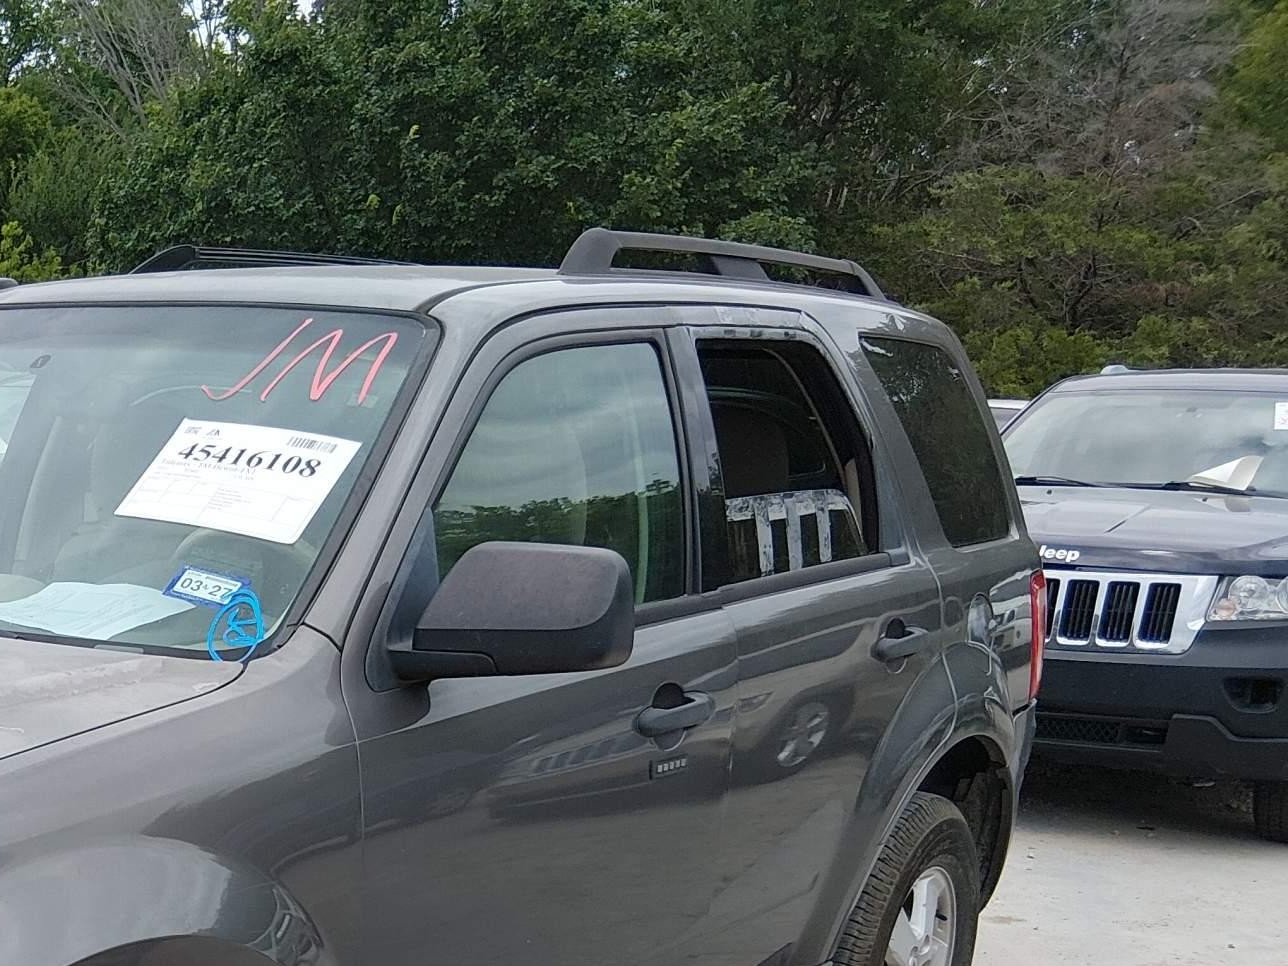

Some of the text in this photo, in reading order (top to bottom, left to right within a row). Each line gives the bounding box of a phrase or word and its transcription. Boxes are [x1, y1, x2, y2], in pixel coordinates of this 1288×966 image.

[178, 442, 322, 478] 45416108
[180, 577, 203, 592] 03
[207, 584, 233, 599] 27
